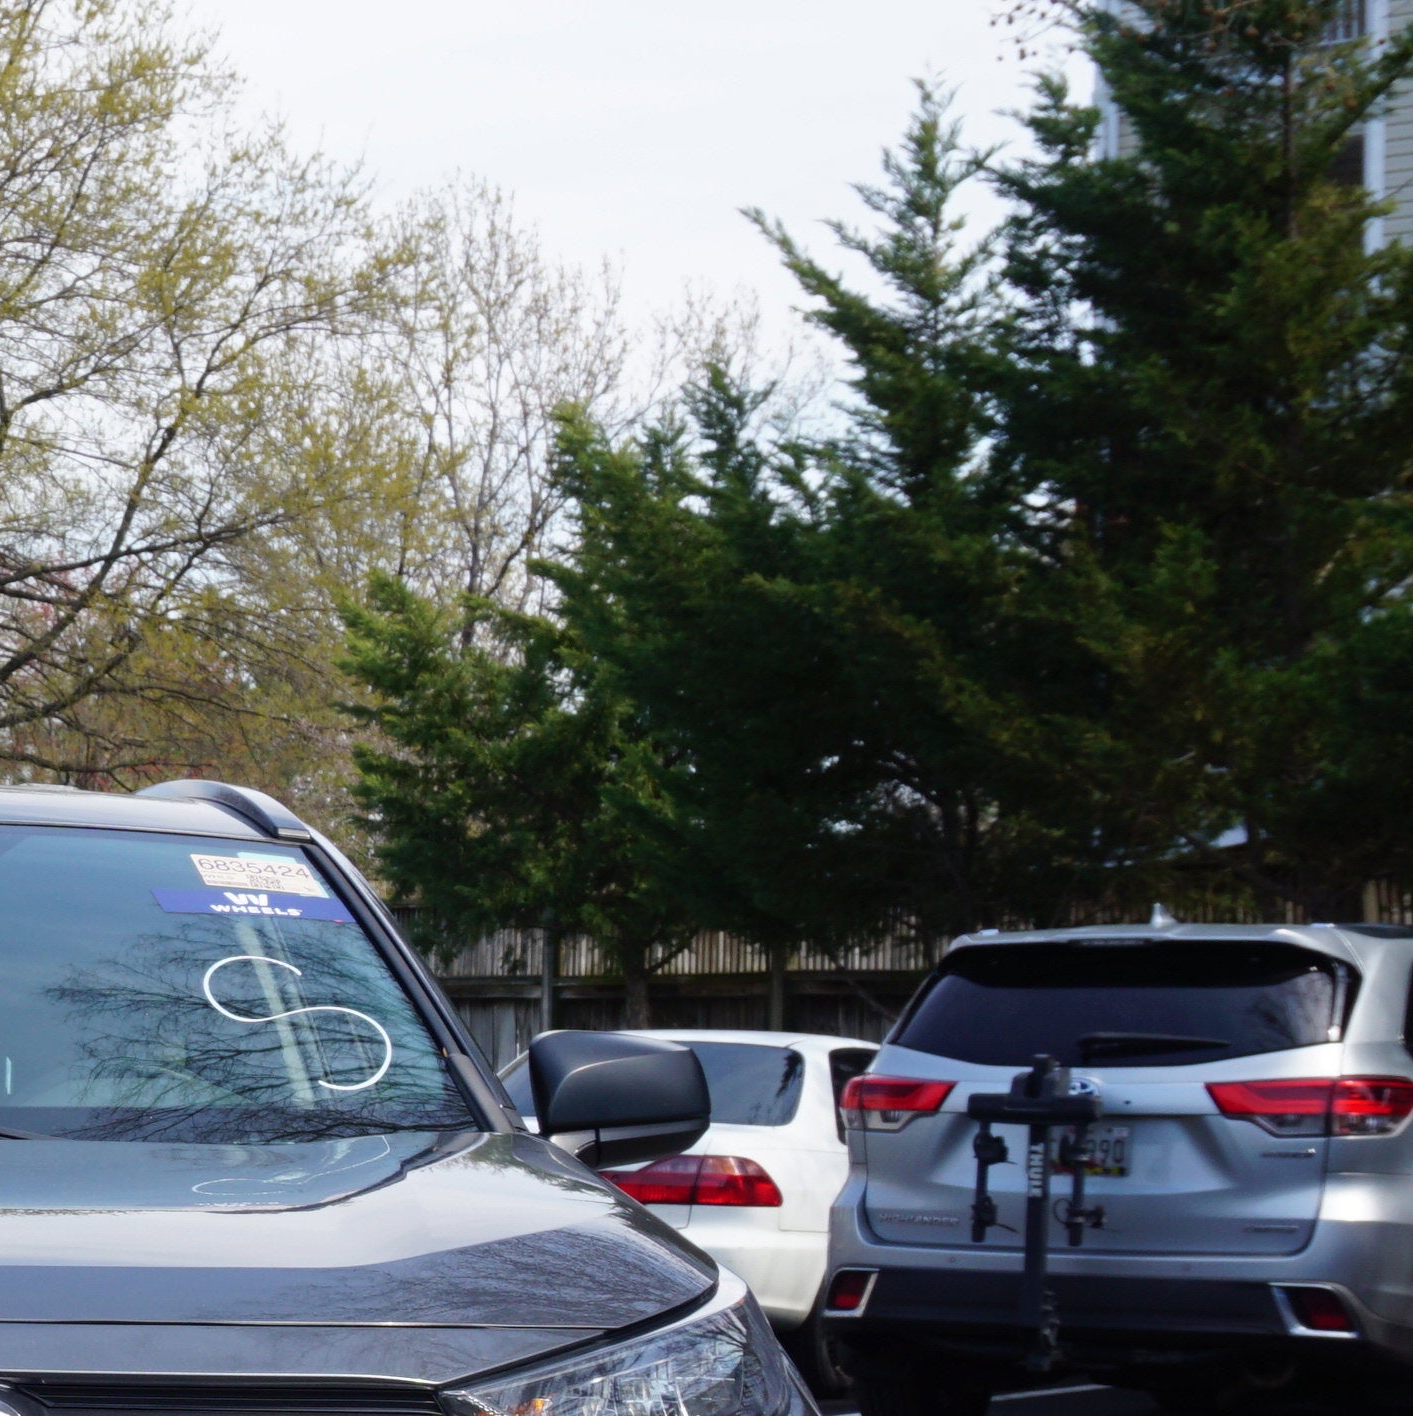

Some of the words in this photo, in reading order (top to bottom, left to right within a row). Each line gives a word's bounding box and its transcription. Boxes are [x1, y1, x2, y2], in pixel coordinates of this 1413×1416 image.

[198, 858, 310, 879] 6835424
[210, 904, 303, 917] WHEELS
[1028, 1142, 1045, 1198] THULE
